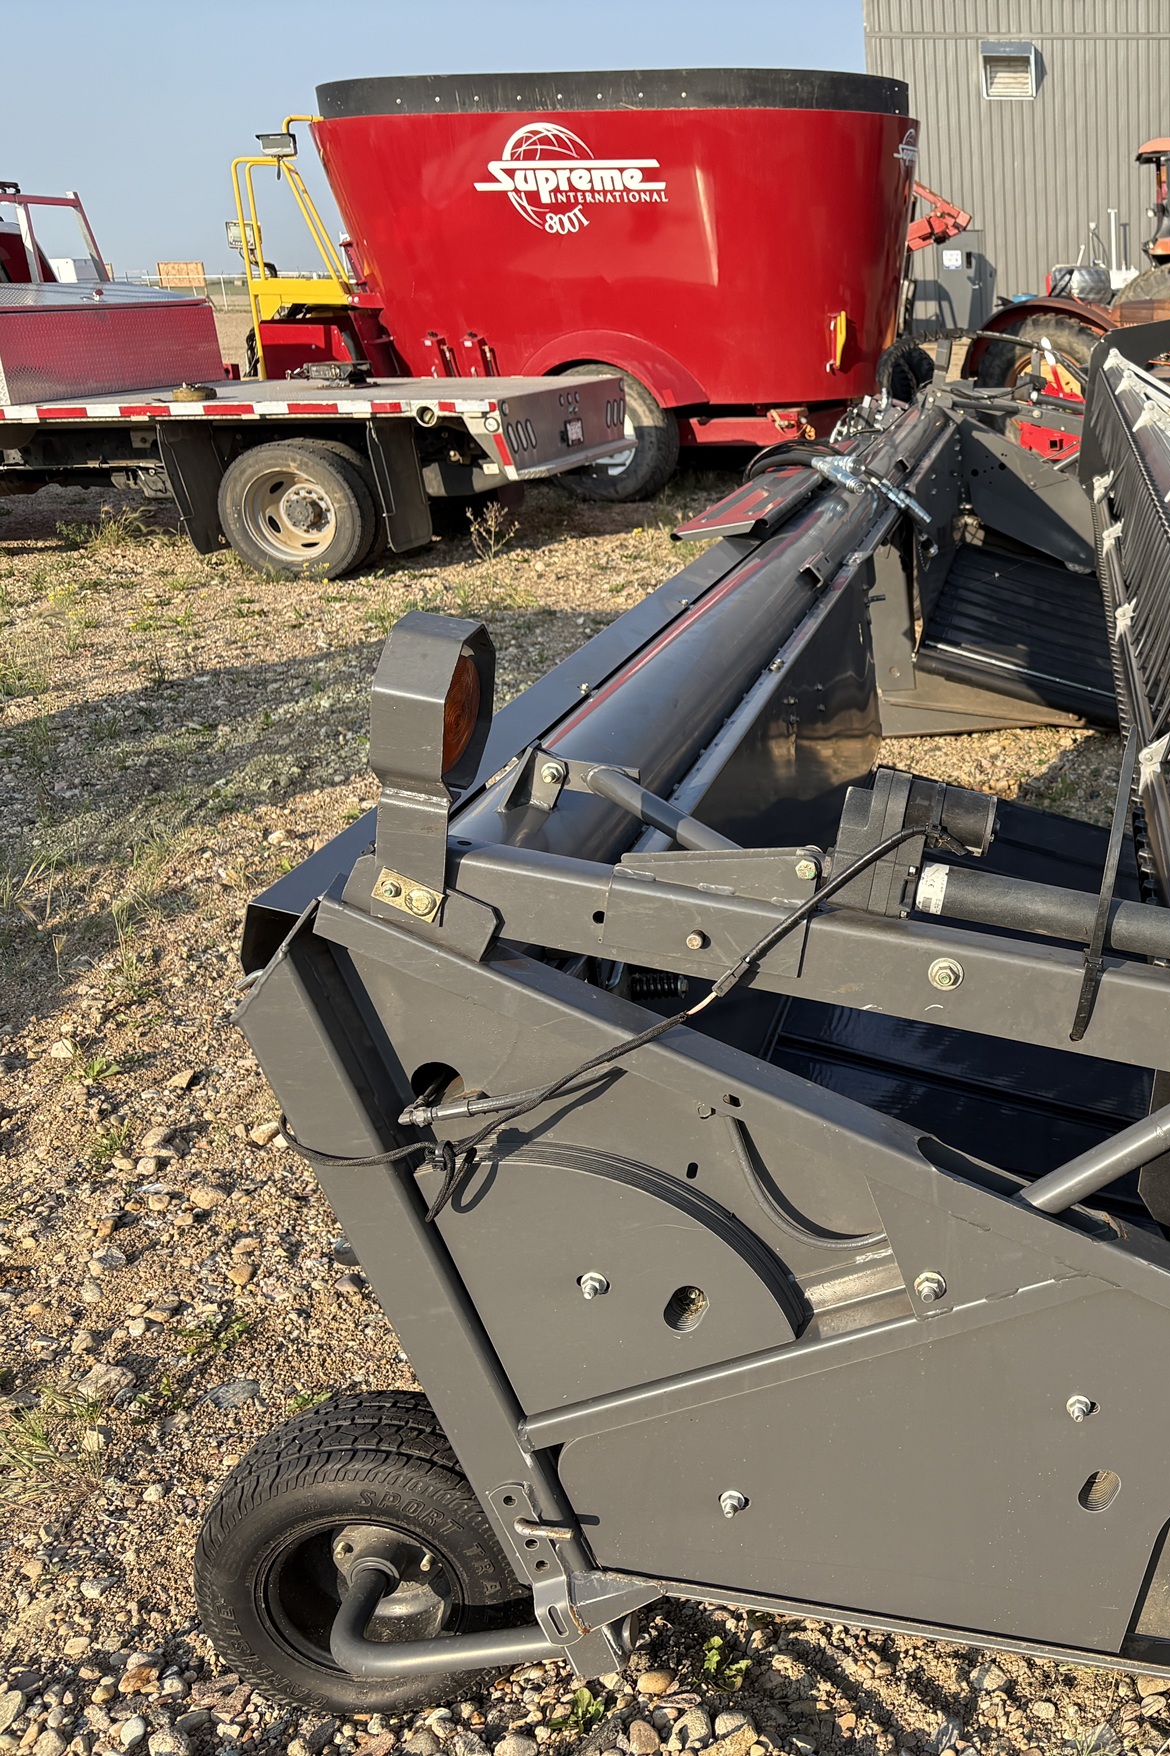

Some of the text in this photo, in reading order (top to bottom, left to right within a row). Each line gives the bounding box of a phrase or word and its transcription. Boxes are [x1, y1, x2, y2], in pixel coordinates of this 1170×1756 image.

[474, 159, 666, 204] Supreme
[550, 191, 669, 203] INTERNATIONAL
[545, 205, 590, 235] 800T
[355, 1488, 464, 1535] SPORT
